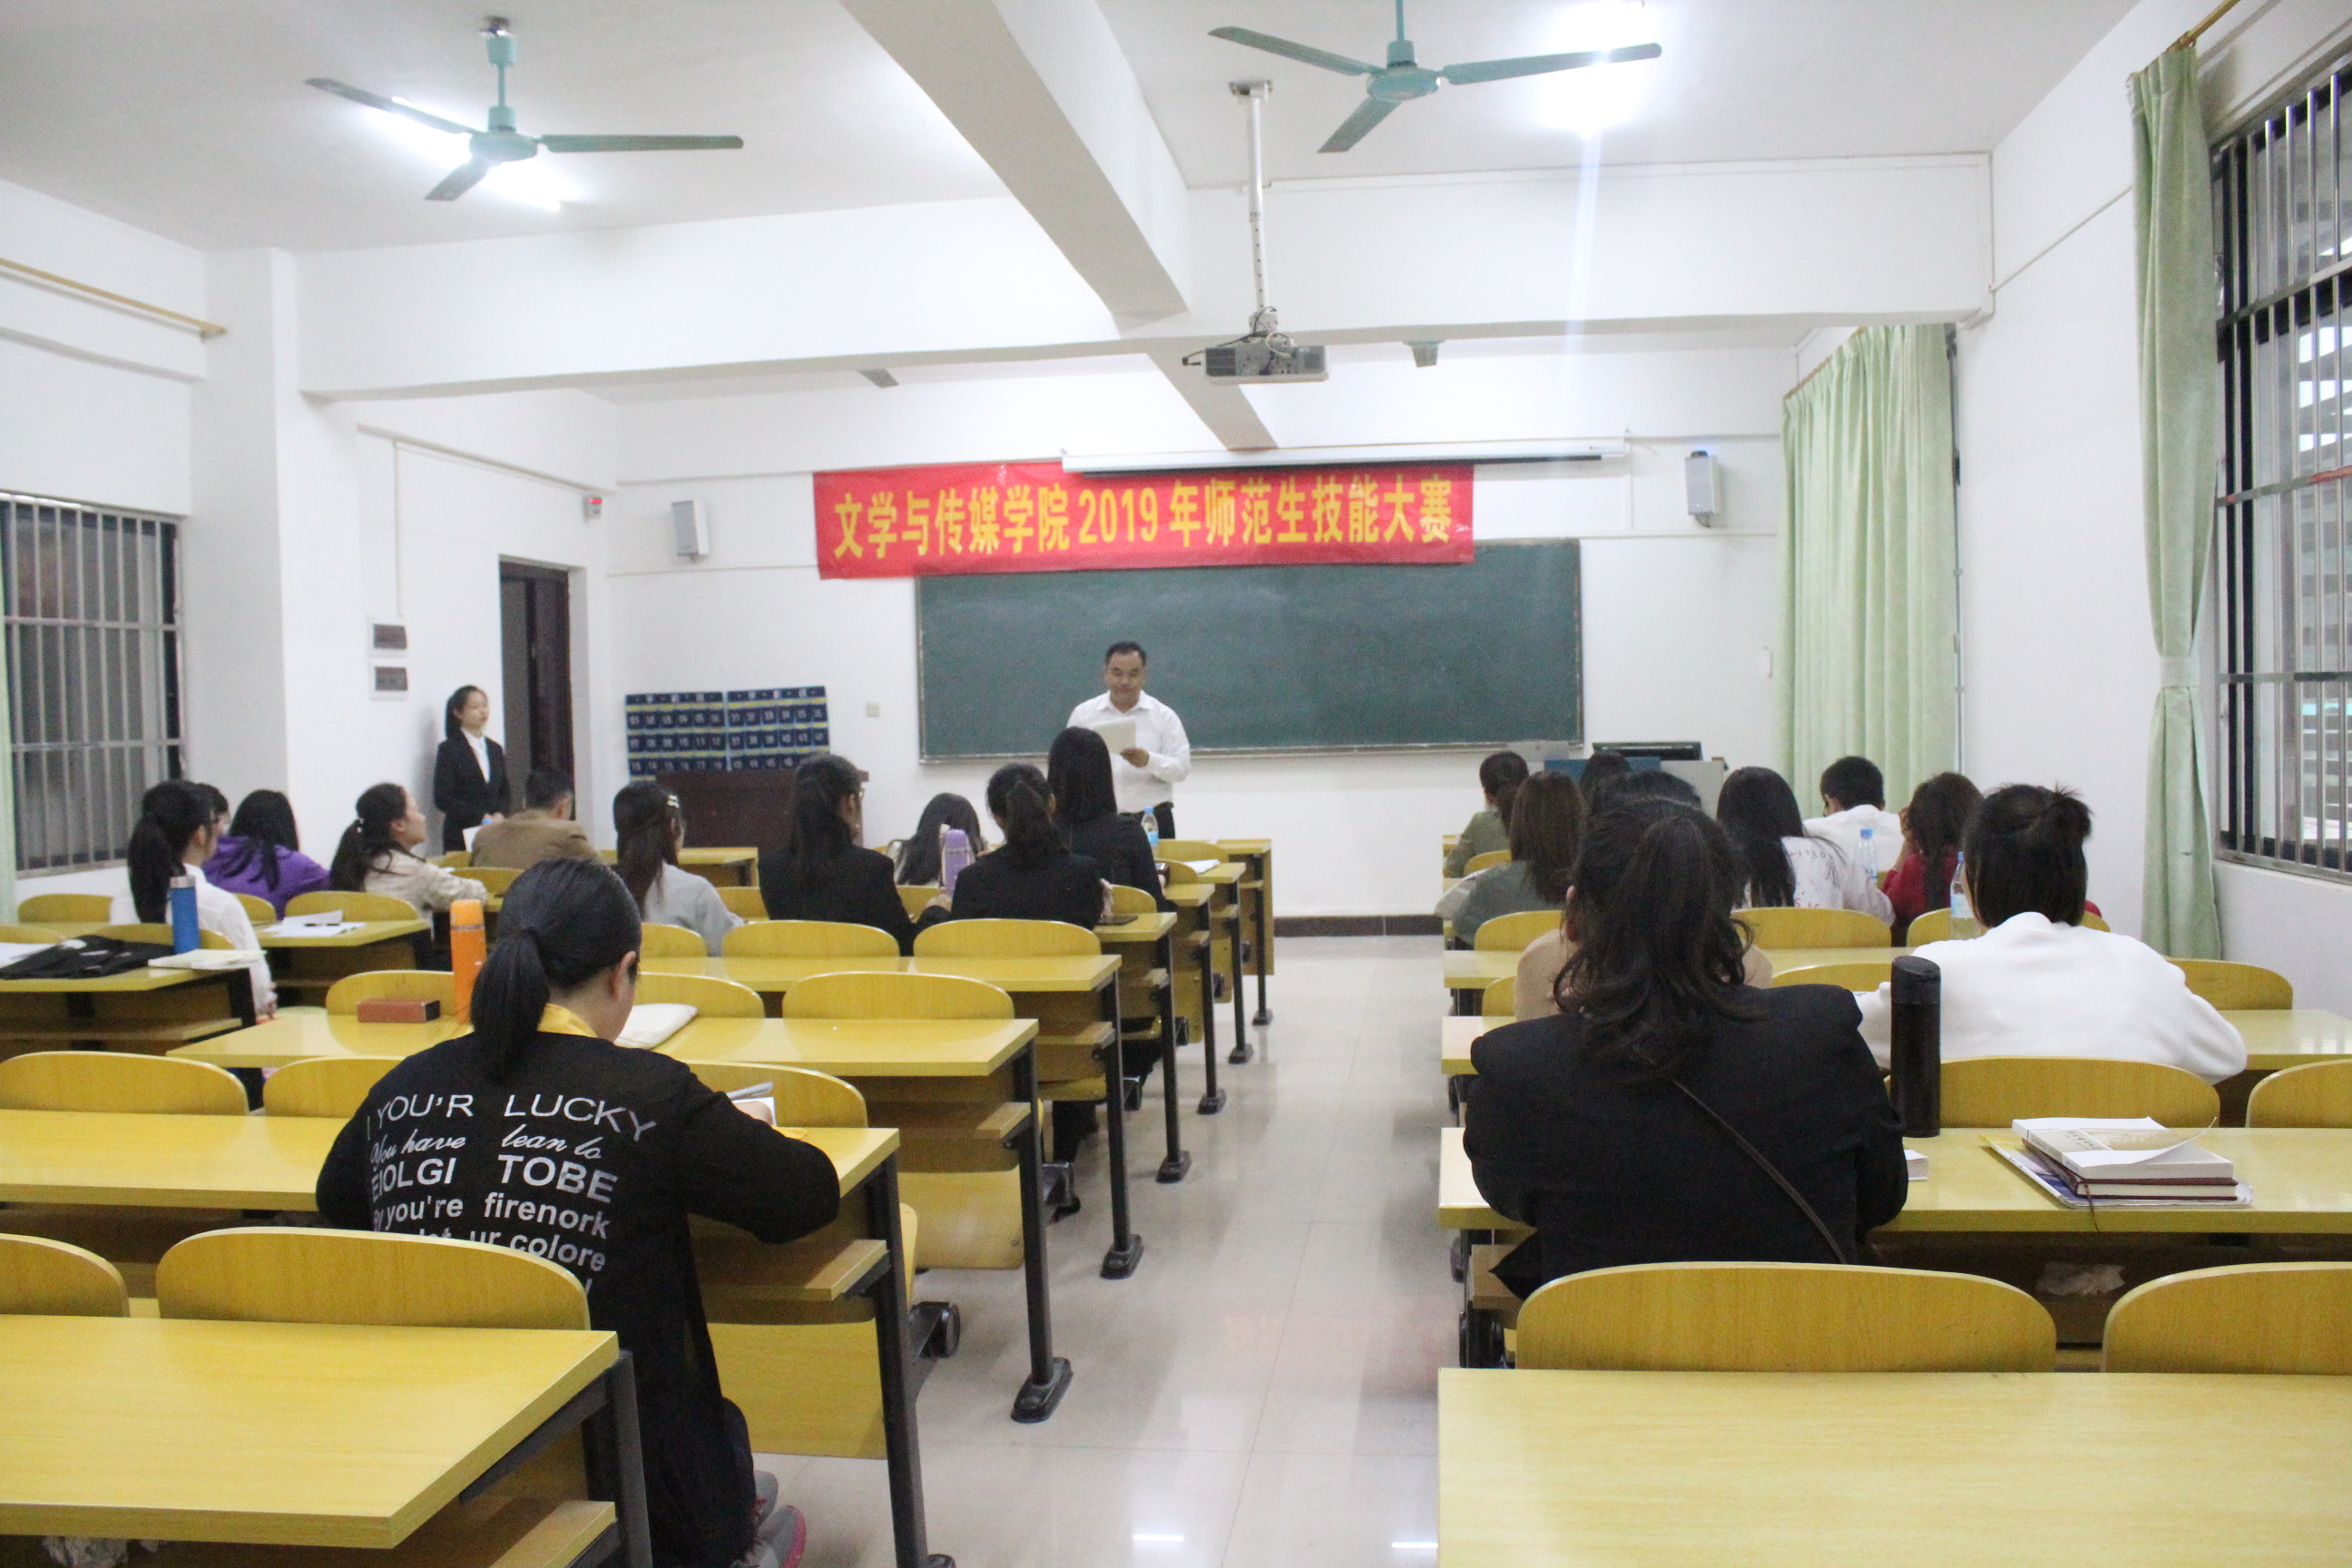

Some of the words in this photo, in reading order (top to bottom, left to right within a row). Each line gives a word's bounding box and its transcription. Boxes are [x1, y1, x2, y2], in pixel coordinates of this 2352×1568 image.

[377, 1093, 474, 1129] YOU'R
[504, 1093, 657, 1142] LUCKY
[400, 1128, 466, 1154] have
[501, 1123, 568, 1152] lean
[498, 1154, 619, 1204] TOBE
[385, 1195, 464, 1230] you're
[484, 1191, 611, 1240] firenork
[509, 1233, 606, 1272] colore
